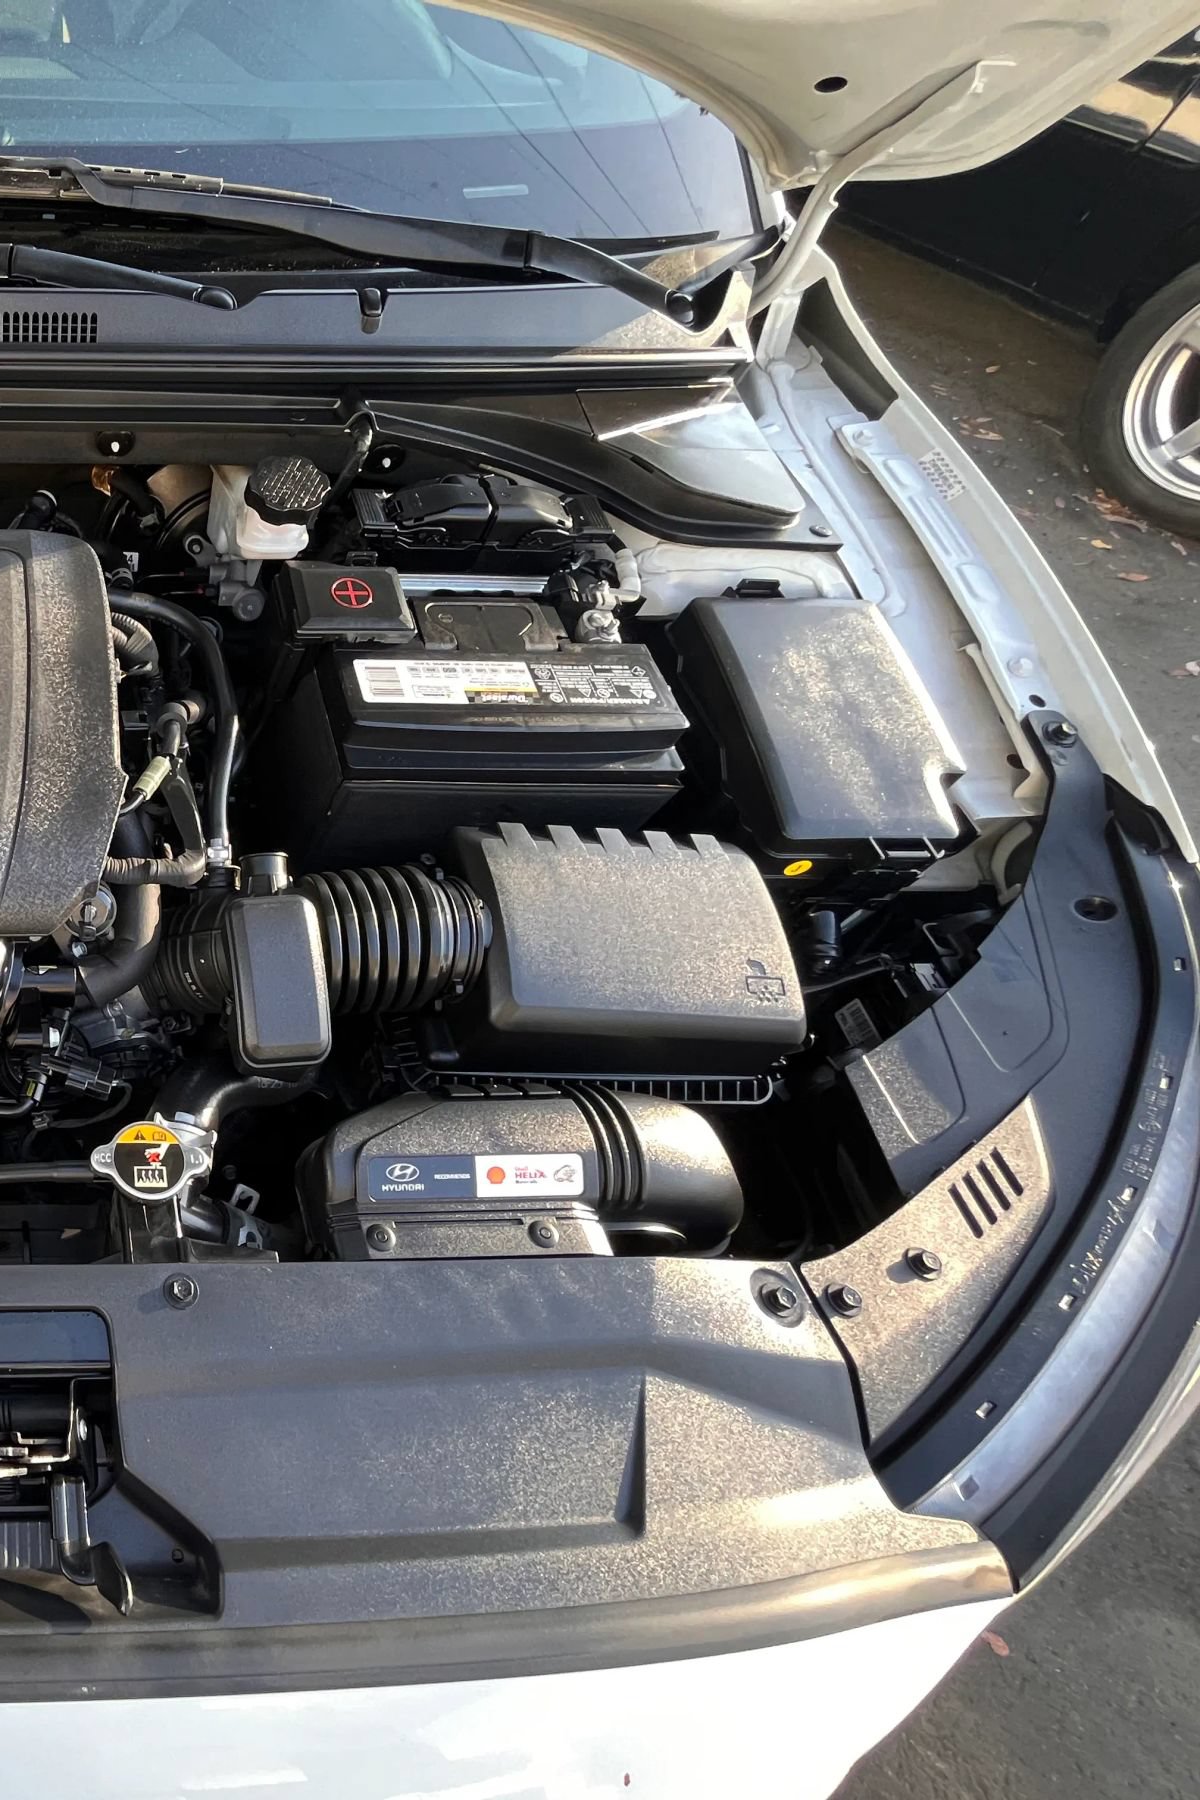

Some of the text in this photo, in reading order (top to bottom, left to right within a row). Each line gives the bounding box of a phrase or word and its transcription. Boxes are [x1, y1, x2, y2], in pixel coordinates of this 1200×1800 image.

[481, 694, 528, 703] Duralast
[94, 1153, 112, 1163] HCC
[190, 1154, 203, 1164] 1.1
[515, 1170, 547, 1179] HELIX
[381, 1183, 425, 1192] HYUNDAI
